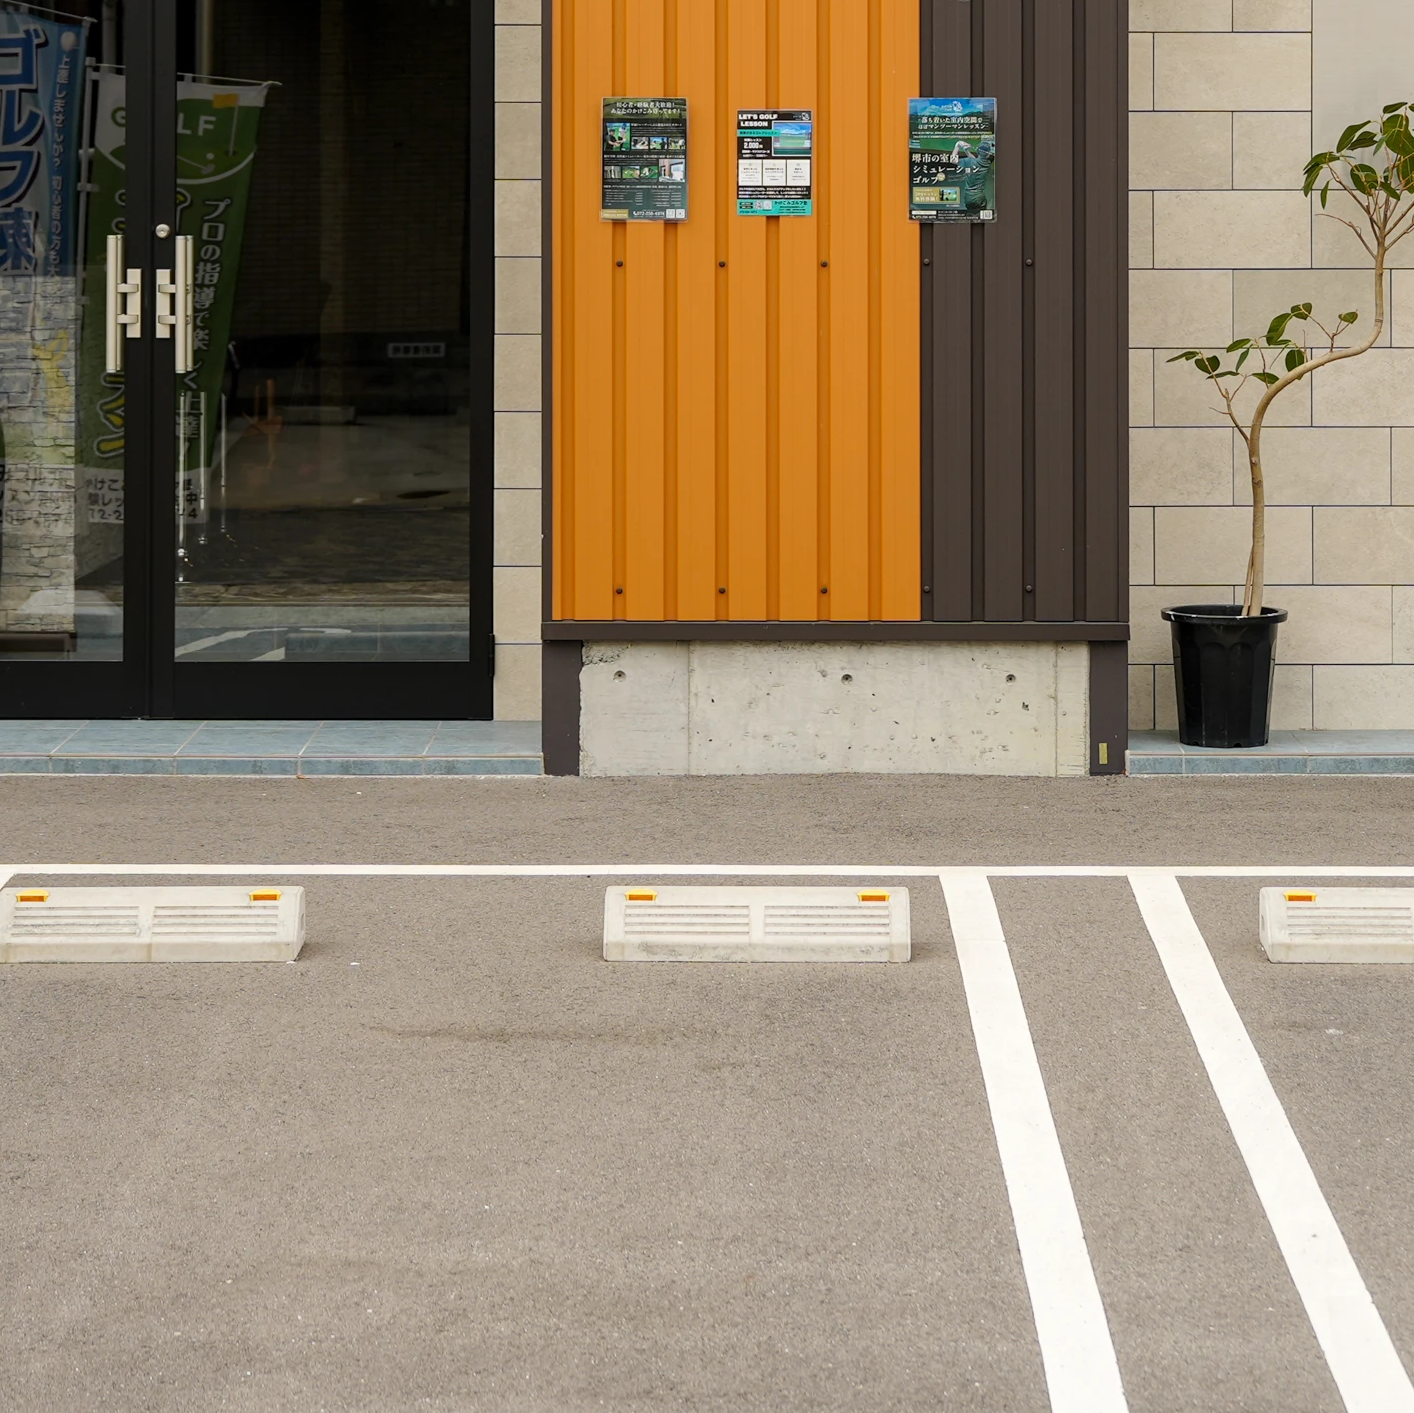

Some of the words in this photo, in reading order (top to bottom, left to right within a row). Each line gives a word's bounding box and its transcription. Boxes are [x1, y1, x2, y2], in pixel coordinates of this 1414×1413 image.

[913, 165, 980, 174] シミュレーション
[912, 175, 938, 185] ゴルフ
